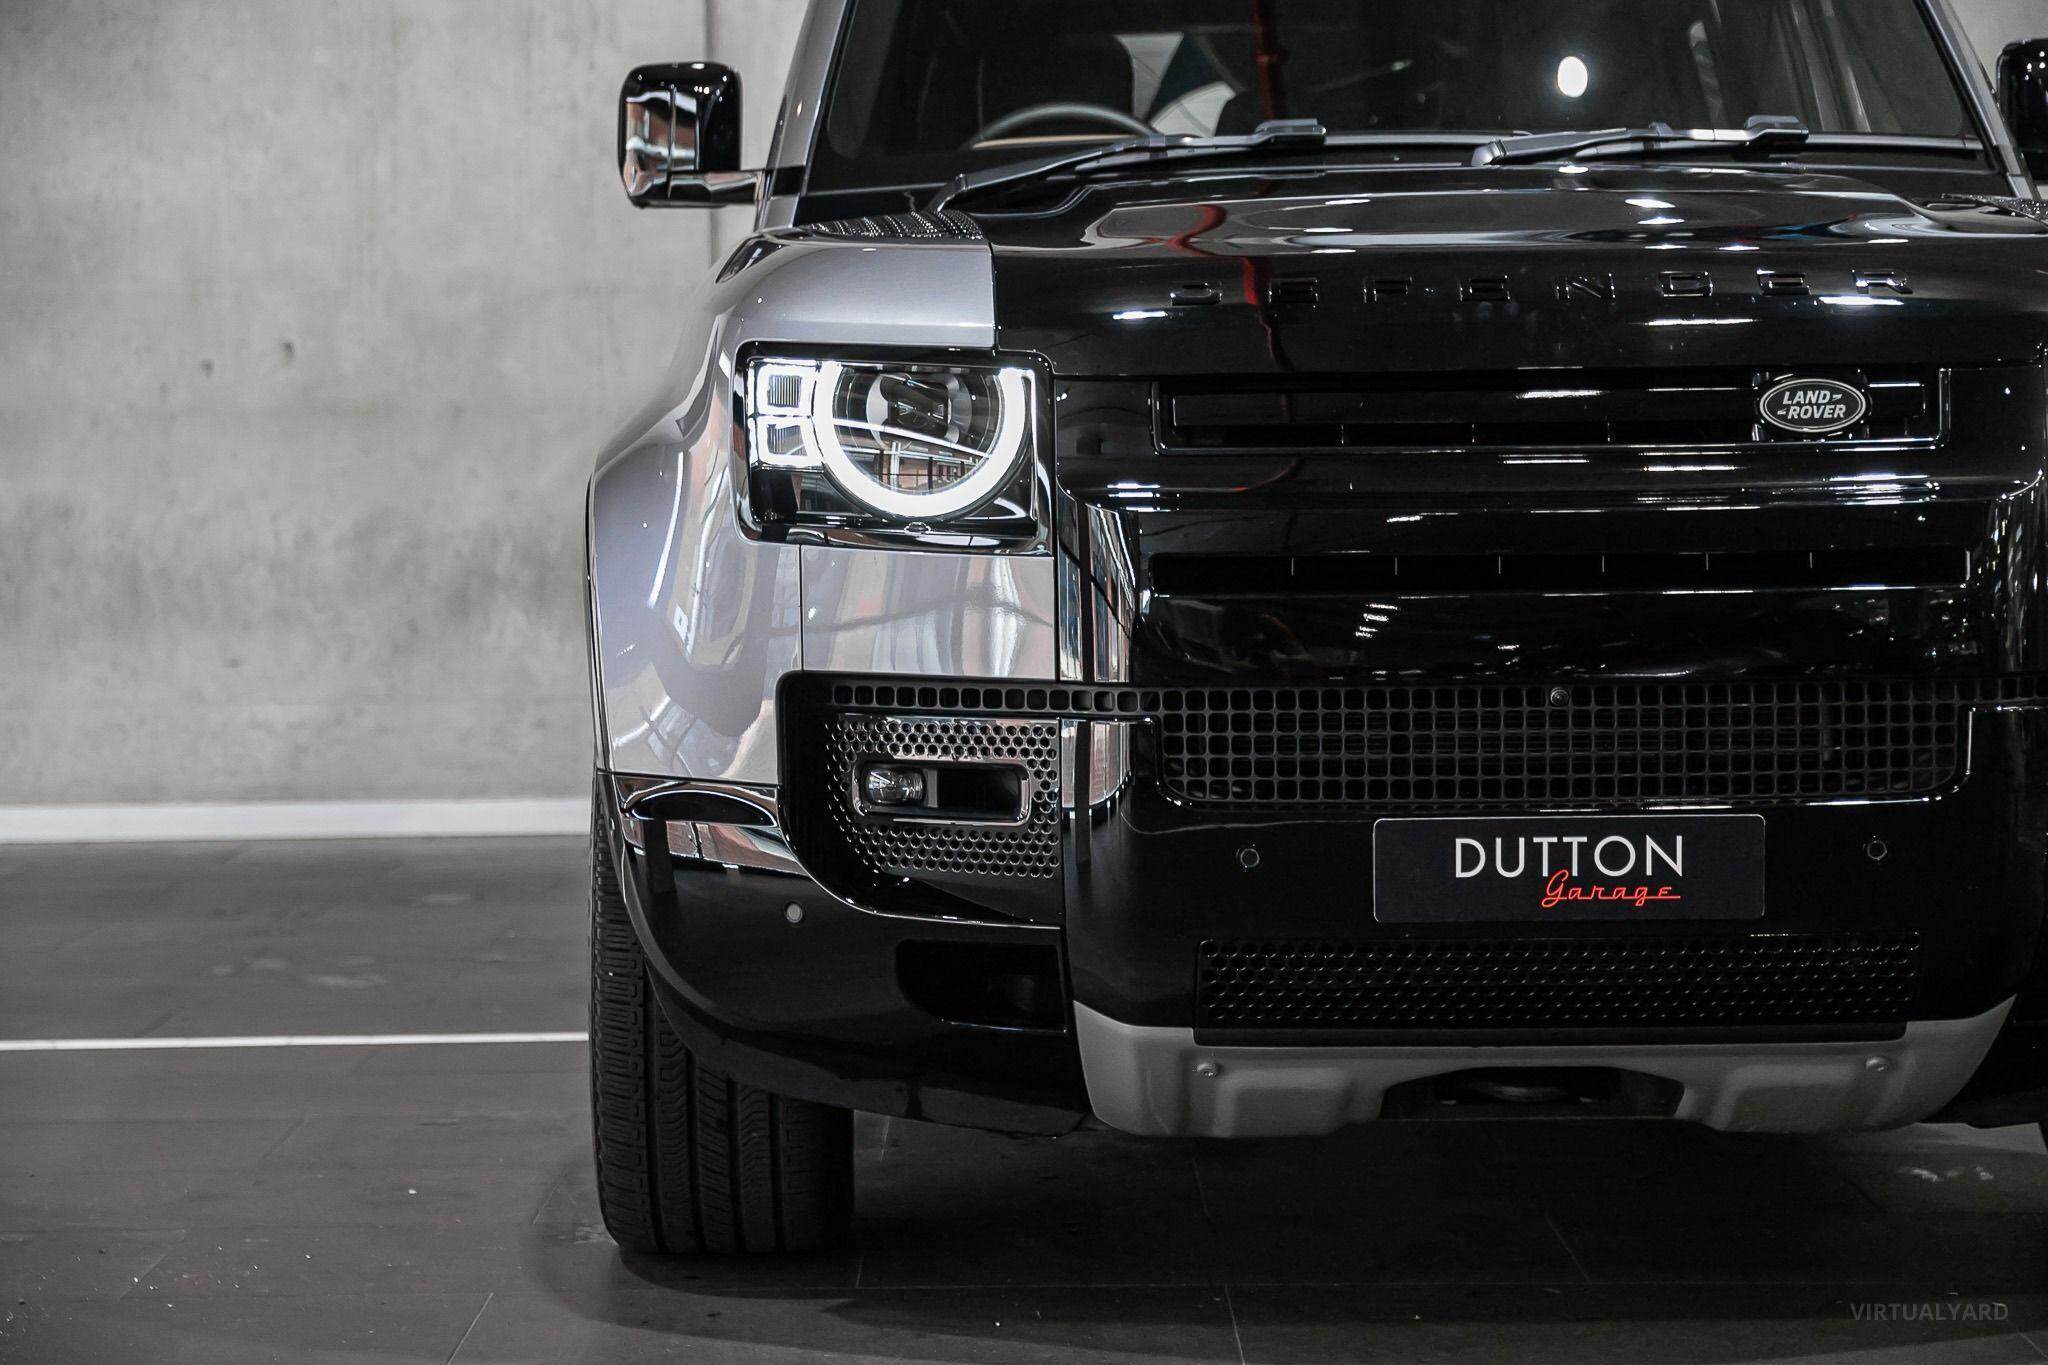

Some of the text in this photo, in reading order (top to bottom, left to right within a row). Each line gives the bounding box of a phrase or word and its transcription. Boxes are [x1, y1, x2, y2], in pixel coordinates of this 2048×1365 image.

[1170, 269, 1914, 305] DEFENDER
[1782, 390, 1831, 405] LAND
[1787, 404, 1846, 419] ROVER
[1455, 834, 1683, 878] DUTTON
[1541, 869, 1681, 908] Garage
